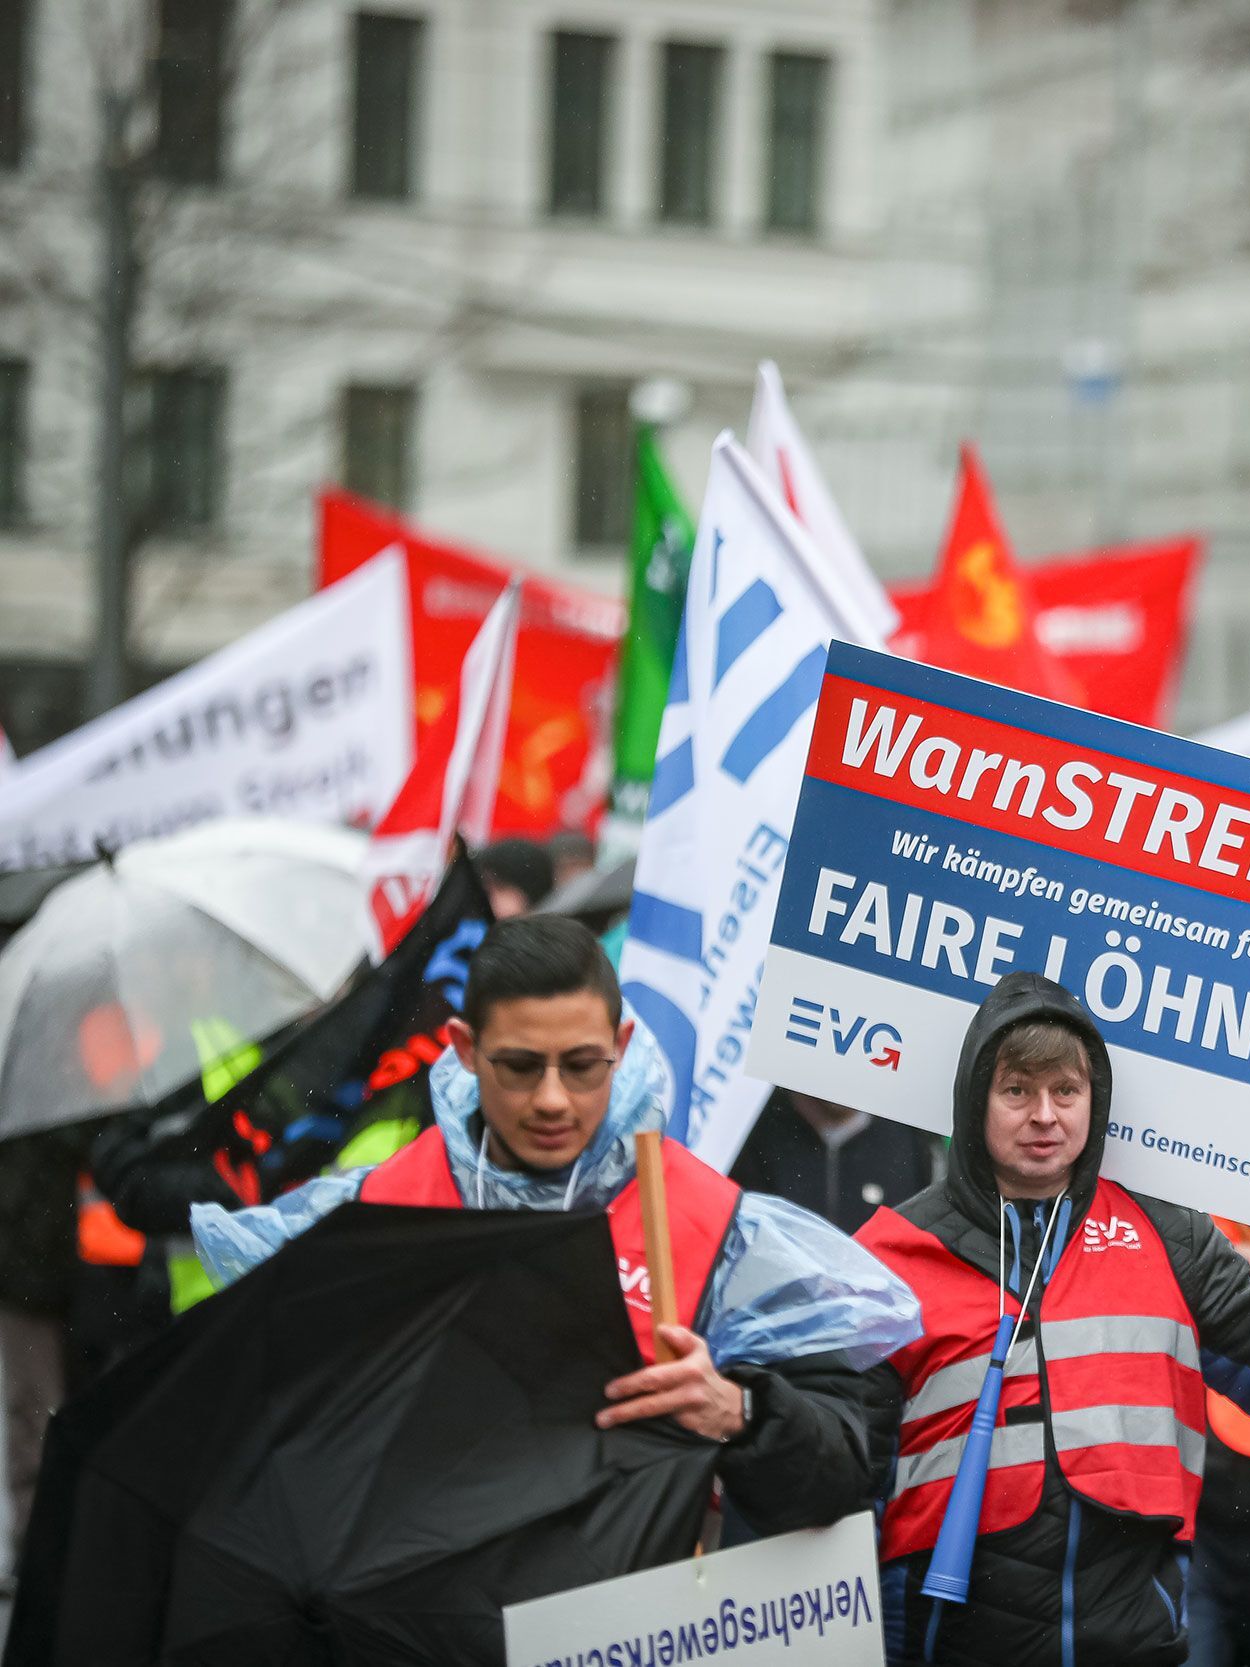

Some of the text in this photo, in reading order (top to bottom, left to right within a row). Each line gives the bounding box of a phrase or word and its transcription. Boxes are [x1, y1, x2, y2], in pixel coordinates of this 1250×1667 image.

[807, 867, 1025, 988] FAIRE
[891, 829, 941, 866] Wir
[941, 844, 1065, 902] kämpfen
[1067, 887, 1231, 951] gemeinsam
[785, 996, 904, 1073] EVG
